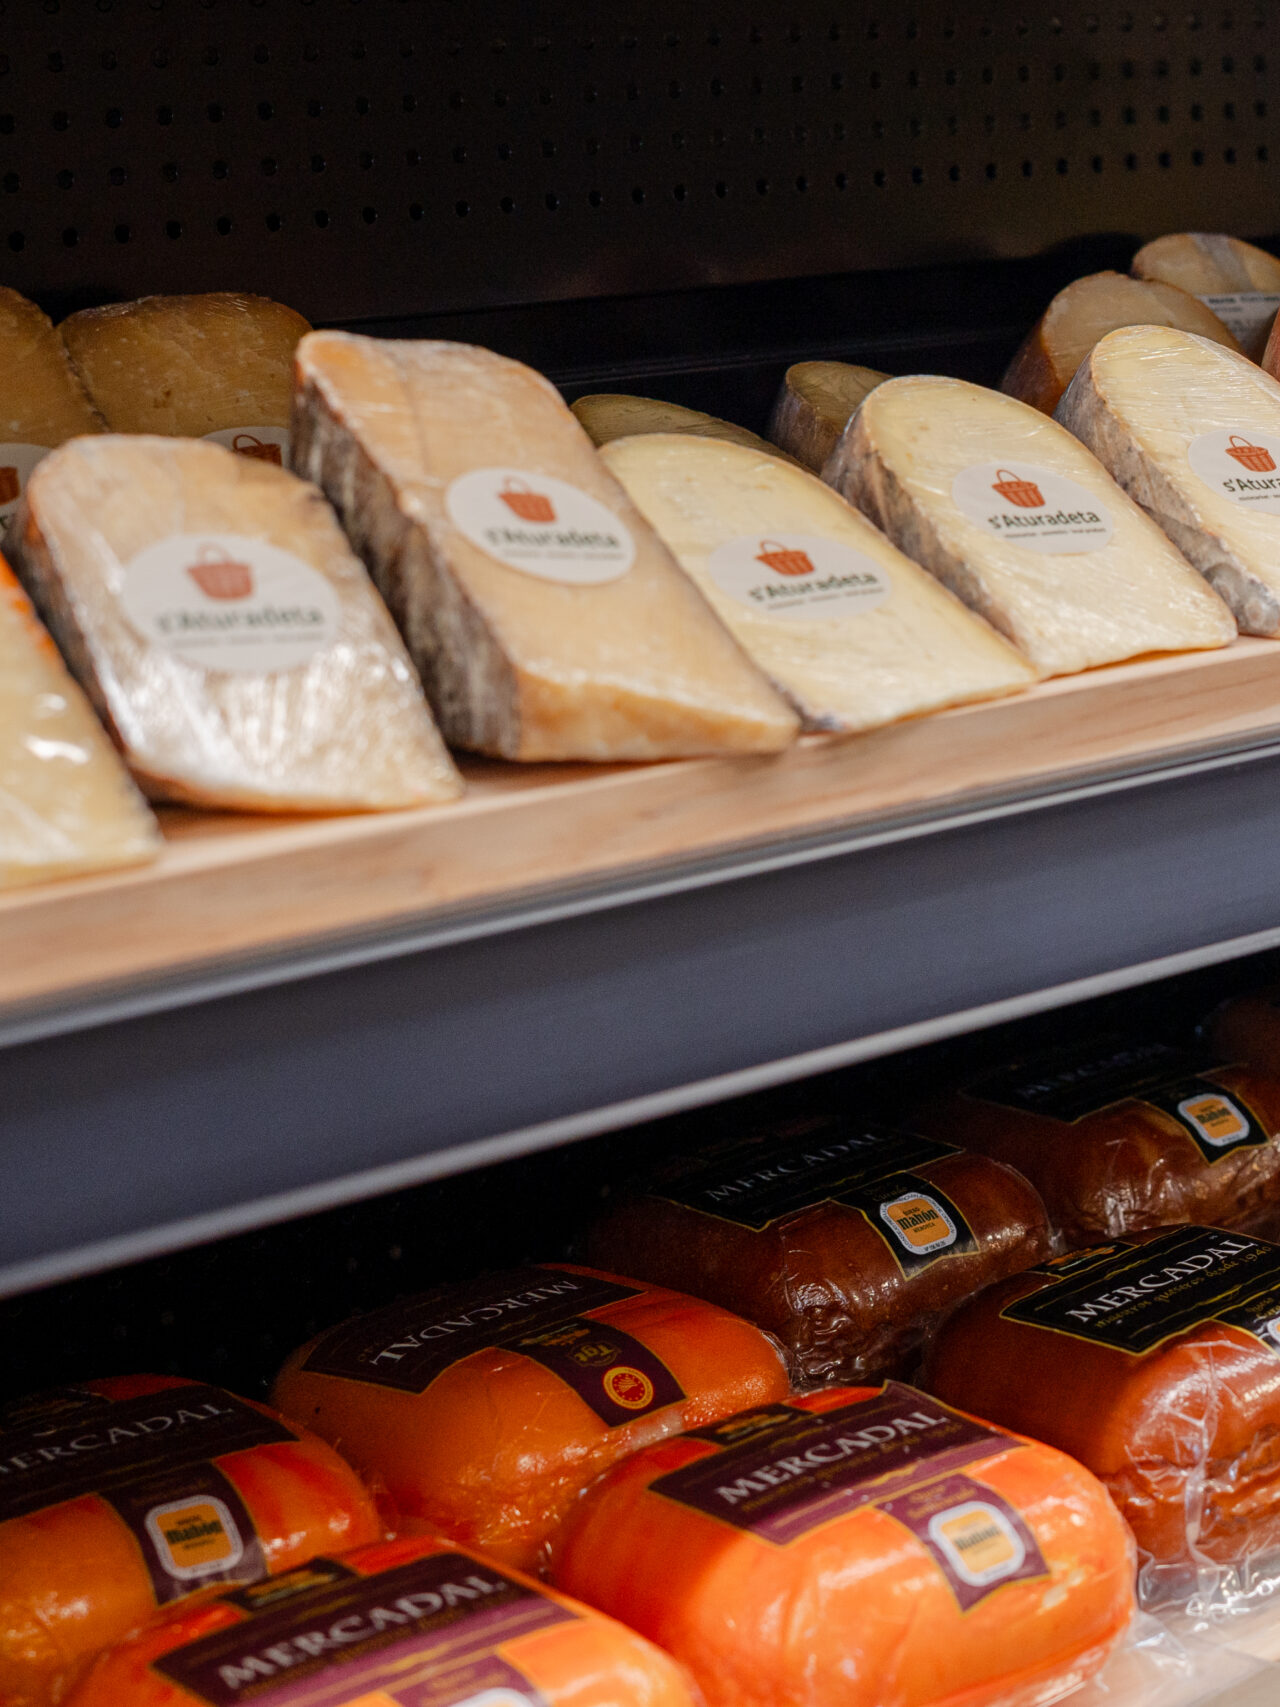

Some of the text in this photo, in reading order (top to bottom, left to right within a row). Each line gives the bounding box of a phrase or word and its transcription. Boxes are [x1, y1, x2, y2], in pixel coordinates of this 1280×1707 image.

[987, 509, 1102, 529] s'Aturadeta
[896, 1208, 939, 1231] Mahón
[367, 1279, 584, 1367] MERCADAL
[1065, 1239, 1259, 1323] MERCADAL
[713, 1409, 950, 1506] MERCADAL
[216, 1574, 509, 1690] MERCADAL
